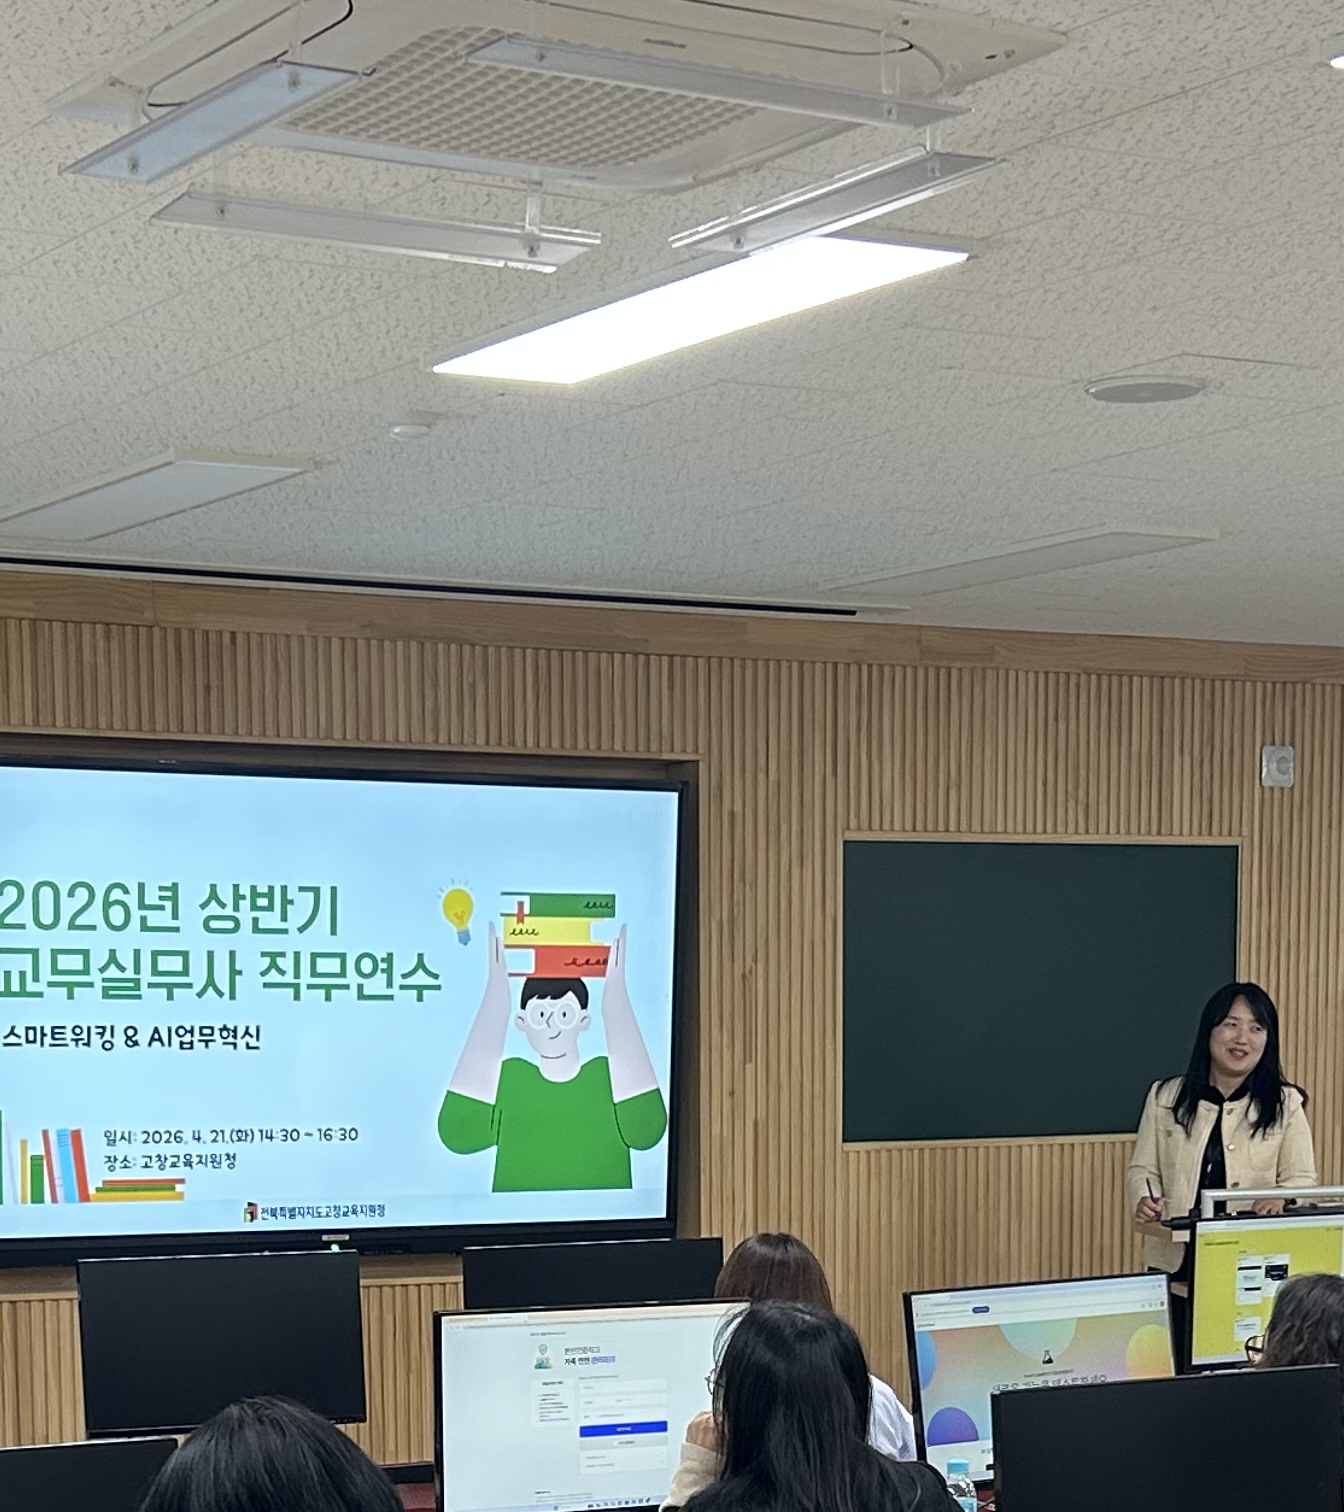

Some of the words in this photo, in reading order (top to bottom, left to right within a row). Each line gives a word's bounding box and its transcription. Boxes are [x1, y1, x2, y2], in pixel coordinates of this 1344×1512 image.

[199, 883, 339, 937] 상반기
[259, 949, 442, 1002] 직무연수
[2, 1024, 116, 1052] 스마트워킹
[124, 1025, 140, 1049] &
[148, 1024, 262, 1051] AI업무혁신
[104, 1129, 137, 1147] 일시:
[141, 1129, 189, 1145] 2026.
[191, 1129, 207, 1145] 4.
[259, 1128, 300, 1143] 14:30
[317, 1127, 359, 1142] 16:30
[104, 1153, 137, 1172] 장소:
[140, 1152, 237, 1171] 고창교육지원청
